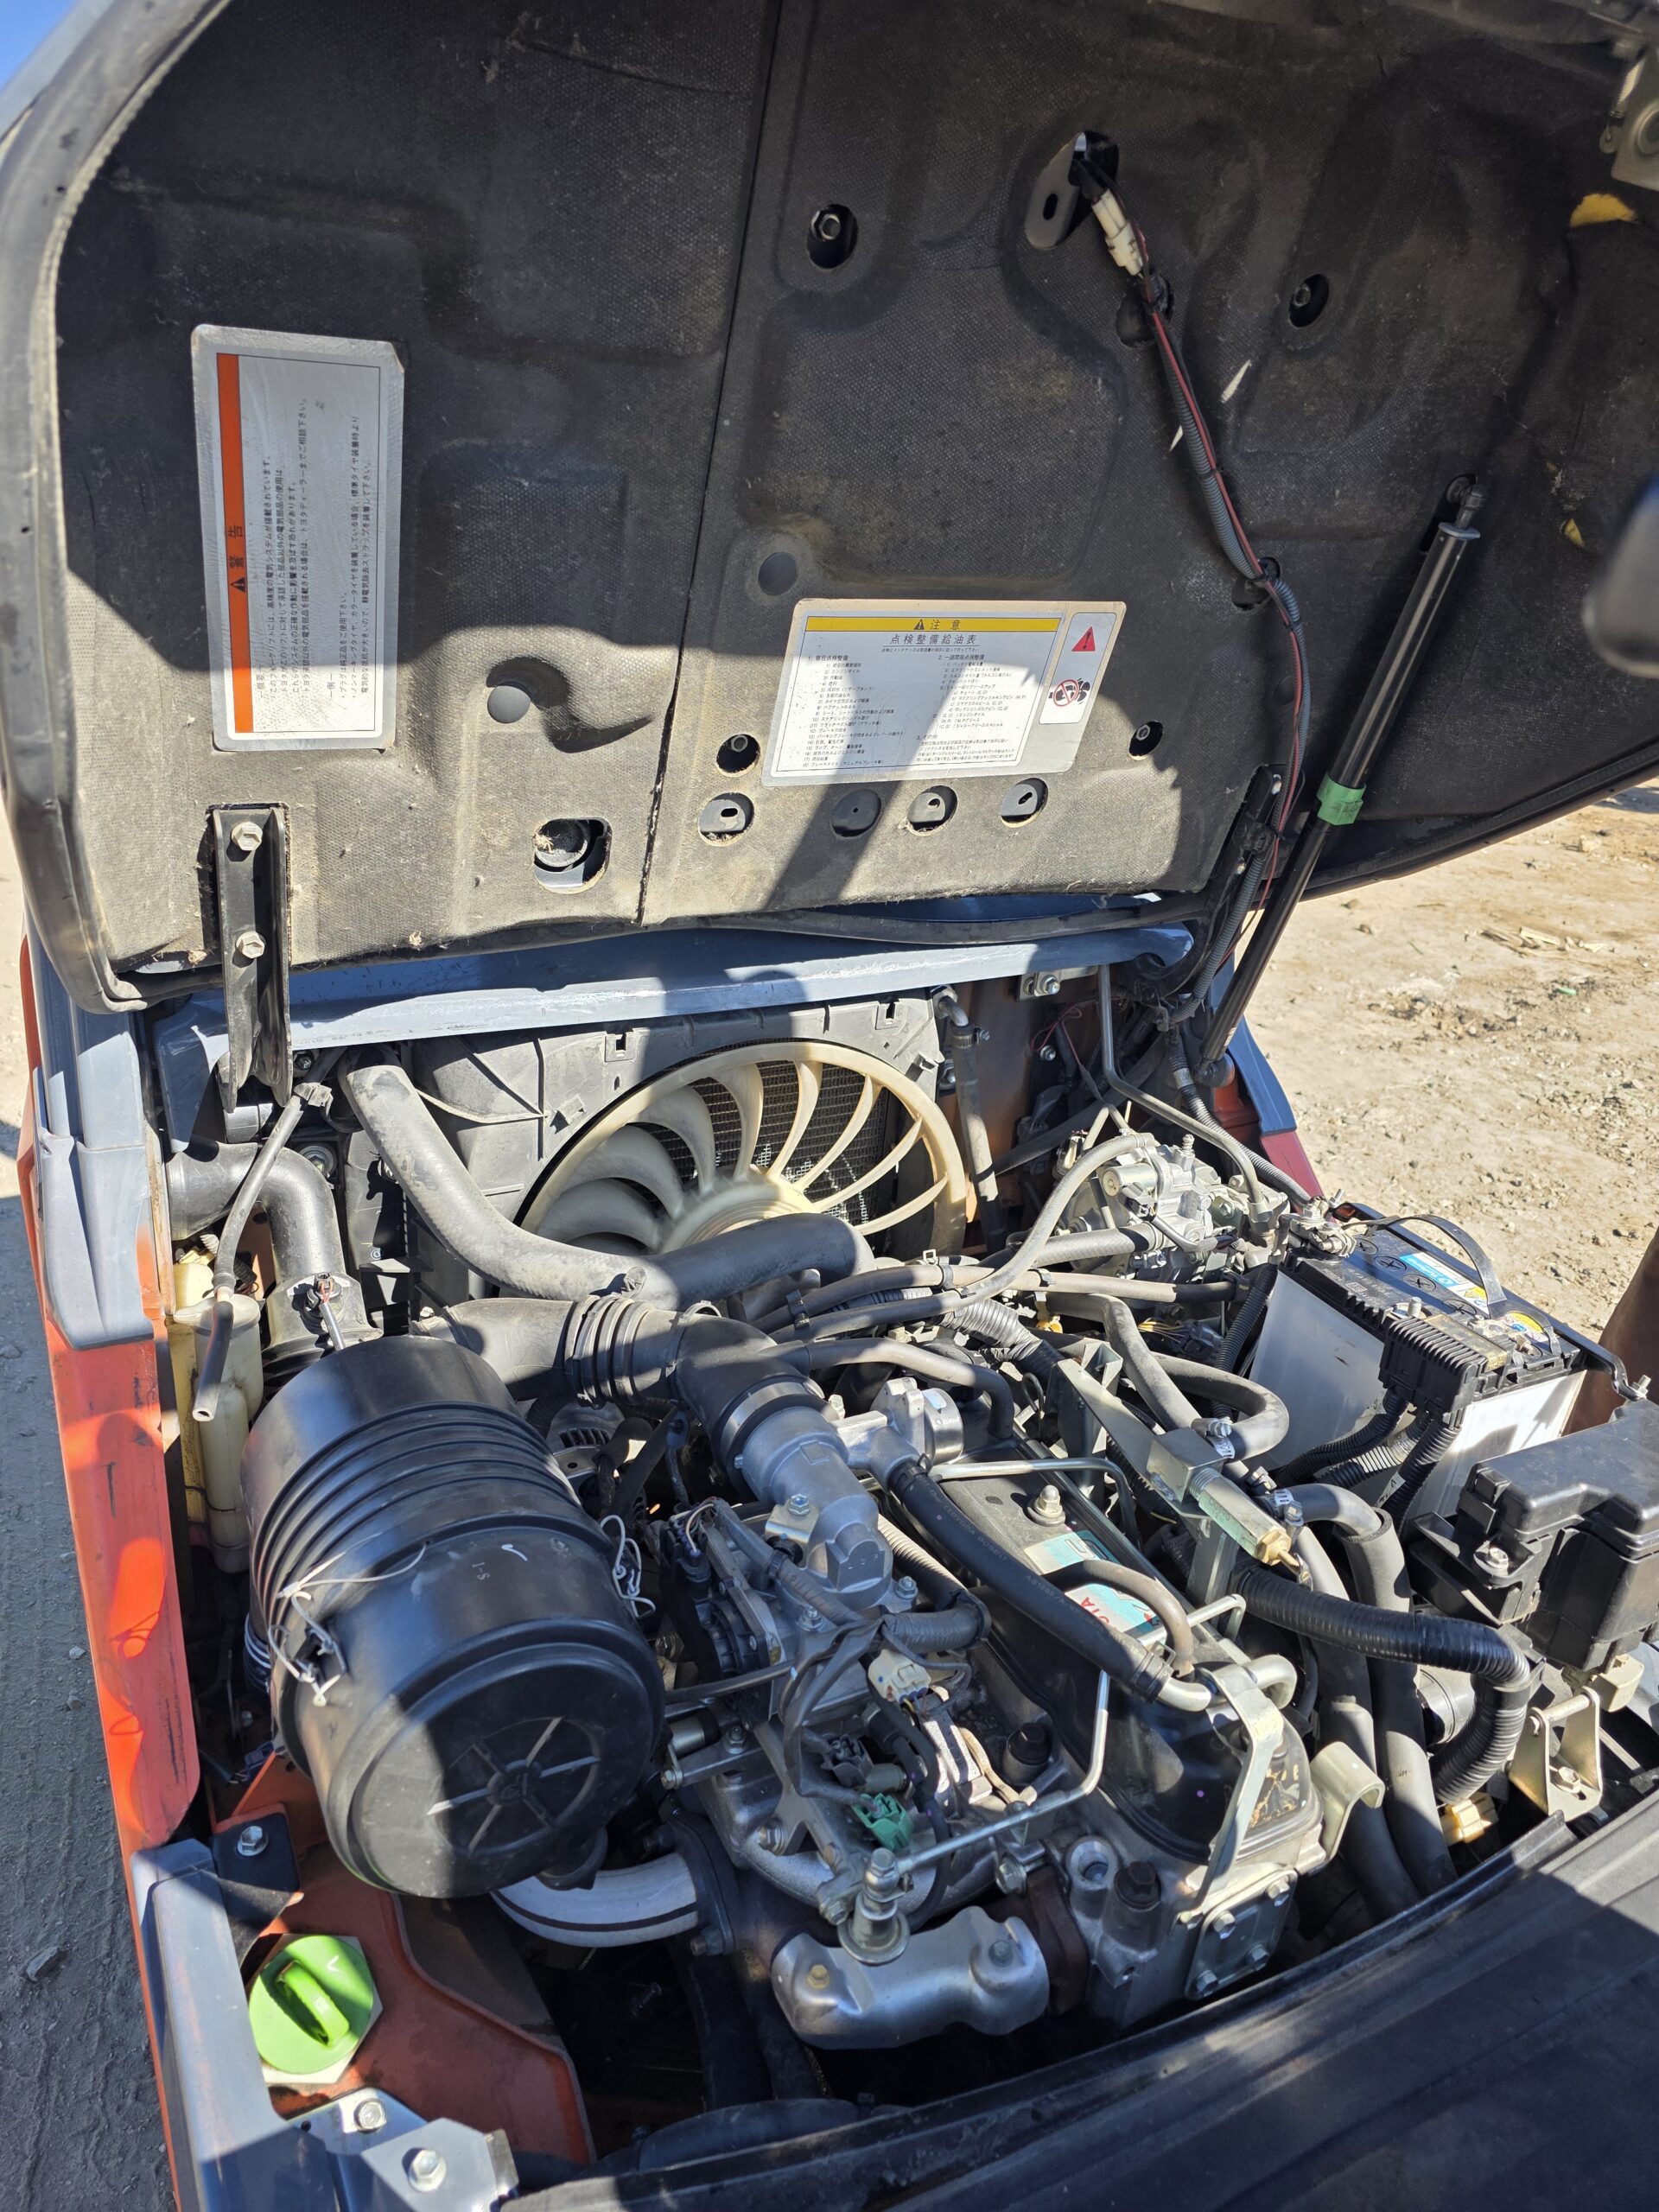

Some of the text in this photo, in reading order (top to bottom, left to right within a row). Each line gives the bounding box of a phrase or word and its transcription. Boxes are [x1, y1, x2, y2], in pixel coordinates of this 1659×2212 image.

[228, 524, 244, 569] 警告
[929, 619, 962, 630] 注意
[889, 634, 977, 644] 点検整備給油表
